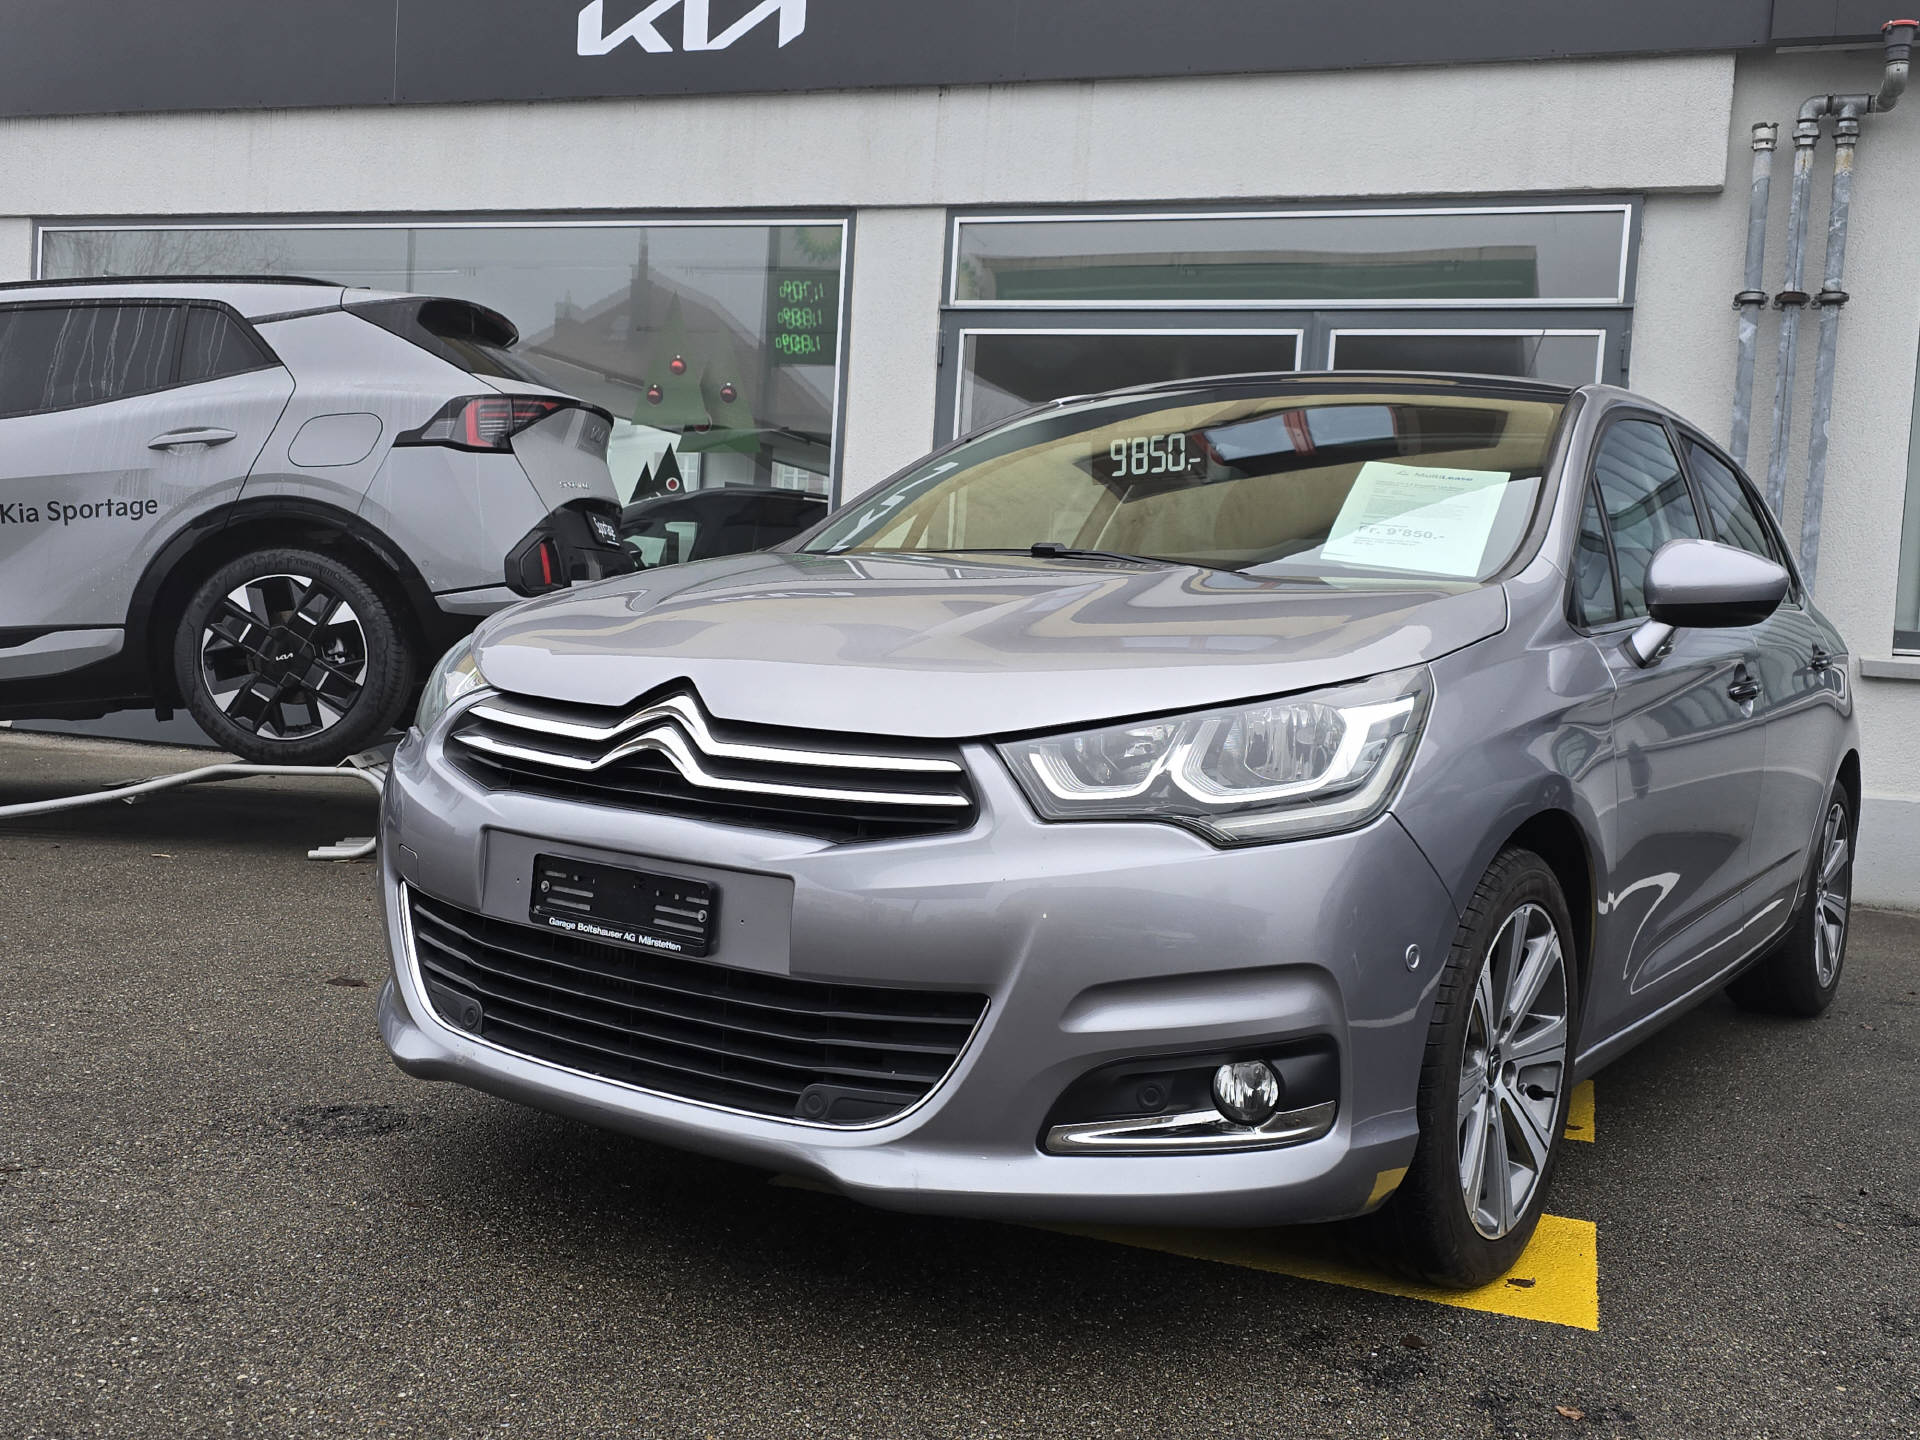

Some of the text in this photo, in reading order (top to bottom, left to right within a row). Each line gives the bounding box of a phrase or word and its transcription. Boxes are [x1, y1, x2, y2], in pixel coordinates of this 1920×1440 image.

[0, 498, 158, 526] Kia Sportage
[548, 917, 682, 952] Garage Boltshauser AG Märstetten
